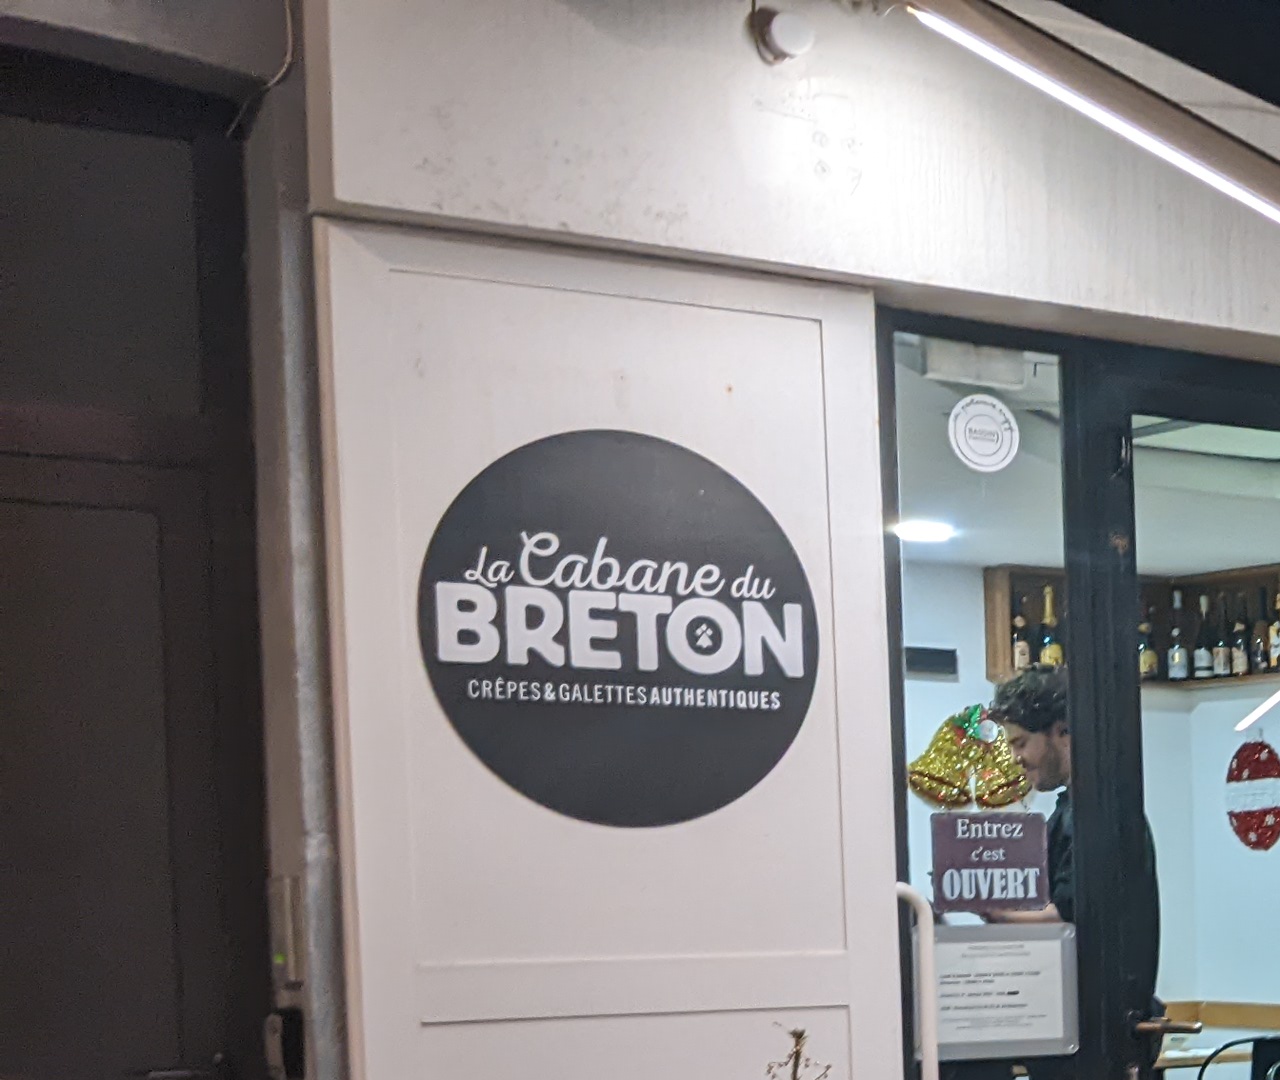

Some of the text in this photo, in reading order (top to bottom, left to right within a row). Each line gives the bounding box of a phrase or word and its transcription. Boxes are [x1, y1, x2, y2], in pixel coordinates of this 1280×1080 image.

[464, 531, 775, 600] La Cabane du
[435, 581, 804, 678] BRETON
[956, 818, 1024, 839] Entrez
[971, 846, 1006, 861] c'est
[942, 868, 1040, 900] OUVERT
